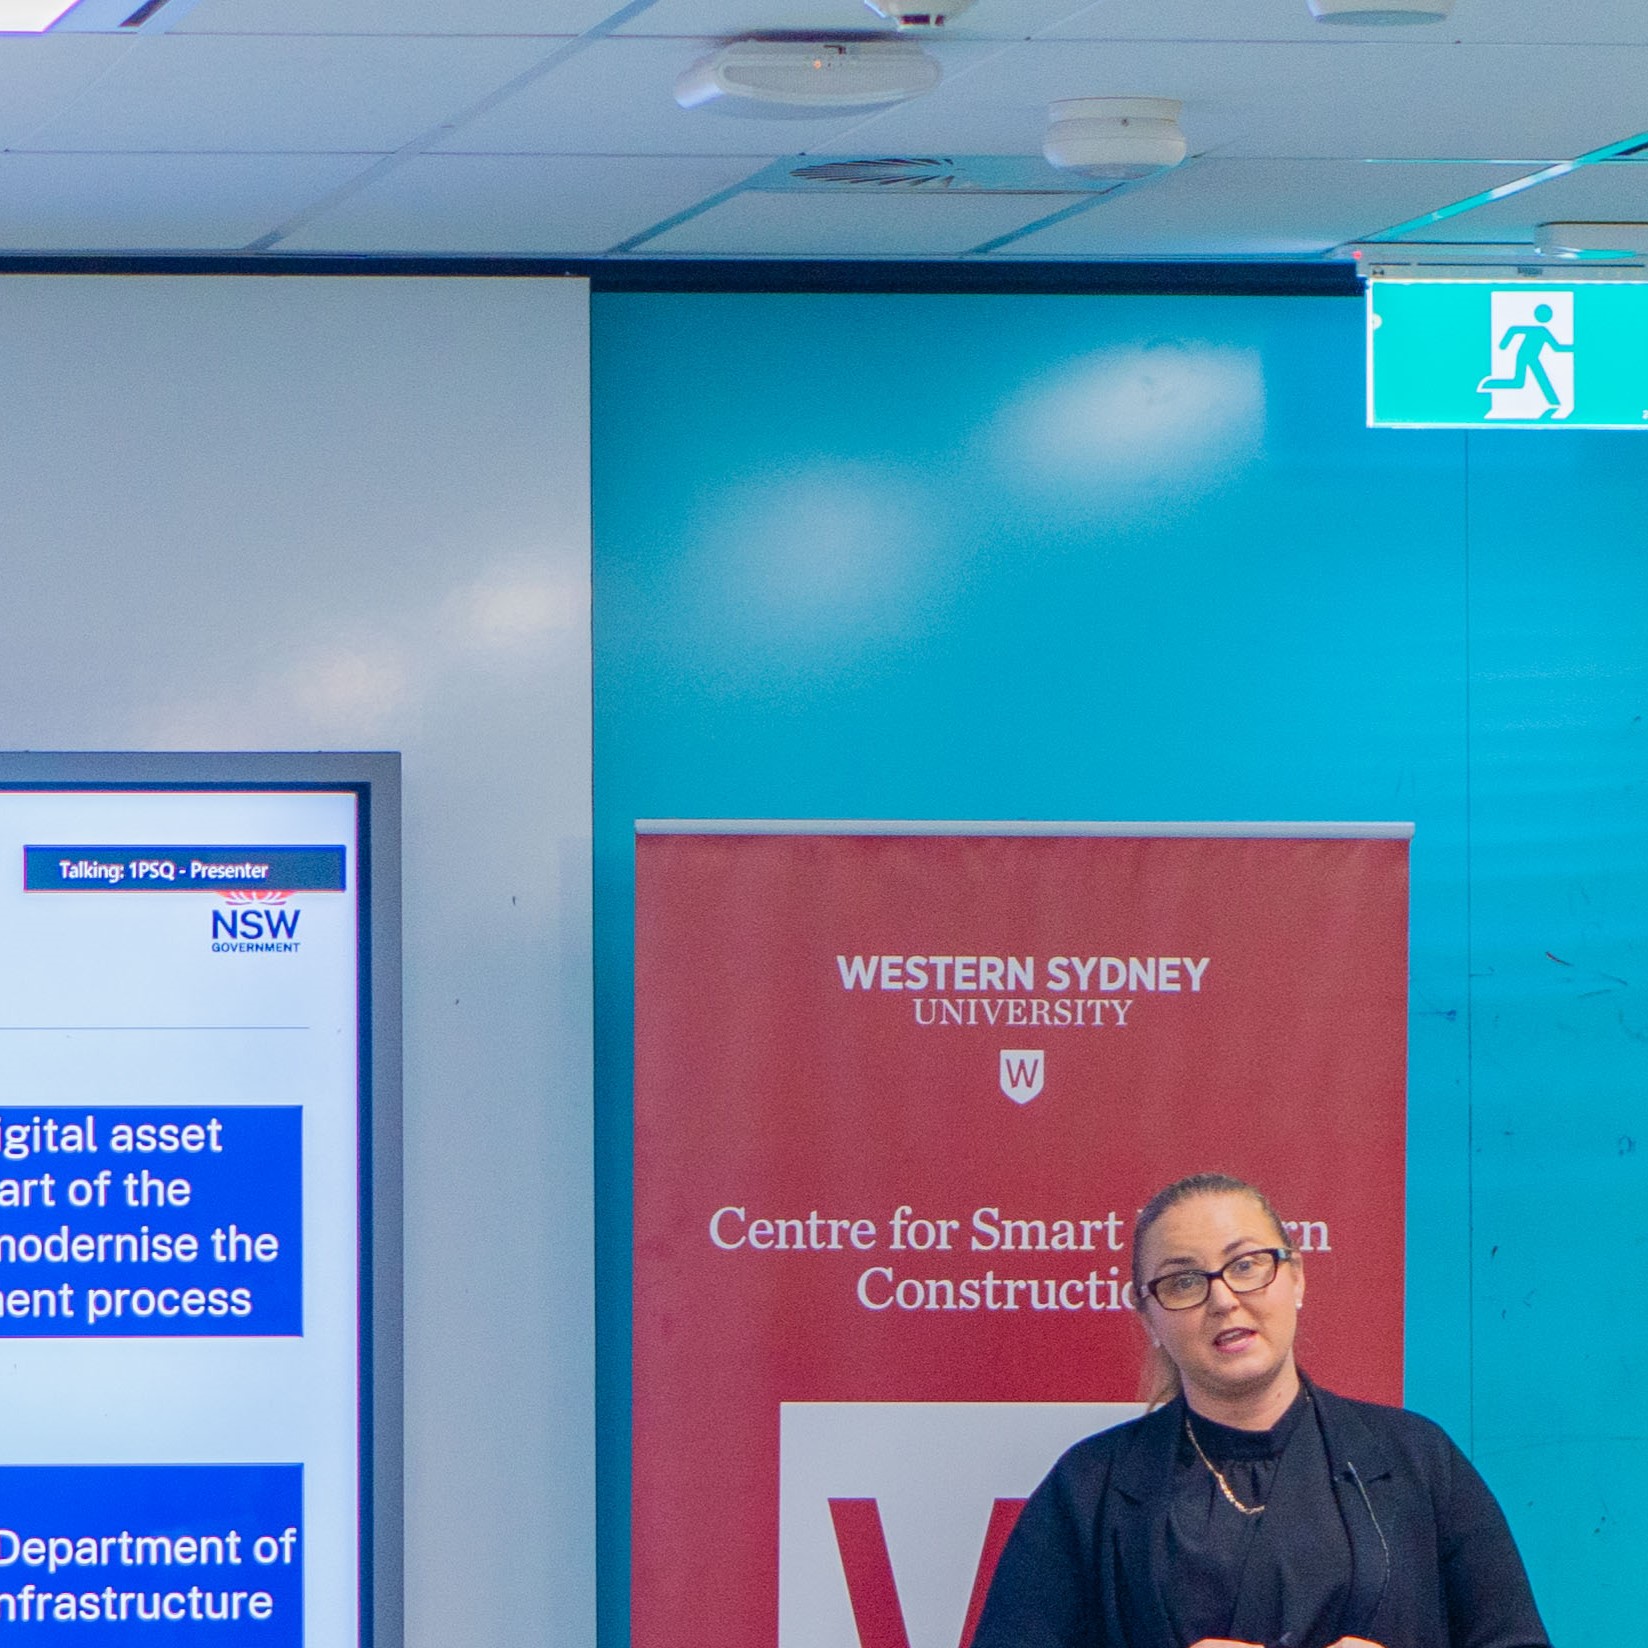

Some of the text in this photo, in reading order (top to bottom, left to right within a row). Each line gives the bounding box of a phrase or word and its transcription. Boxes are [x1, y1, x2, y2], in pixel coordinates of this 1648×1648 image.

[59, 860, 125, 883] Talking:
[128, 861, 176, 882] 1PSQ
[190, 861, 269, 880] Presenter
[212, 909, 301, 940] NSW
[211, 942, 301, 953] GOVERNMENT
[837, 956, 1210, 991] WESTERN SYDNEY
[913, 998, 1133, 1026] UNIVERSITY
[1005, 1058, 1040, 1089] W
[110, 1118, 223, 1153] asset
[67, 1170, 112, 1207] of
[123, 1170, 192, 1207] the
[210, 1224, 279, 1262] the
[708, 1206, 1125, 1252] Centre for Smart
[87, 1287, 253, 1325] process
[253, 1527, 297, 1564] of
